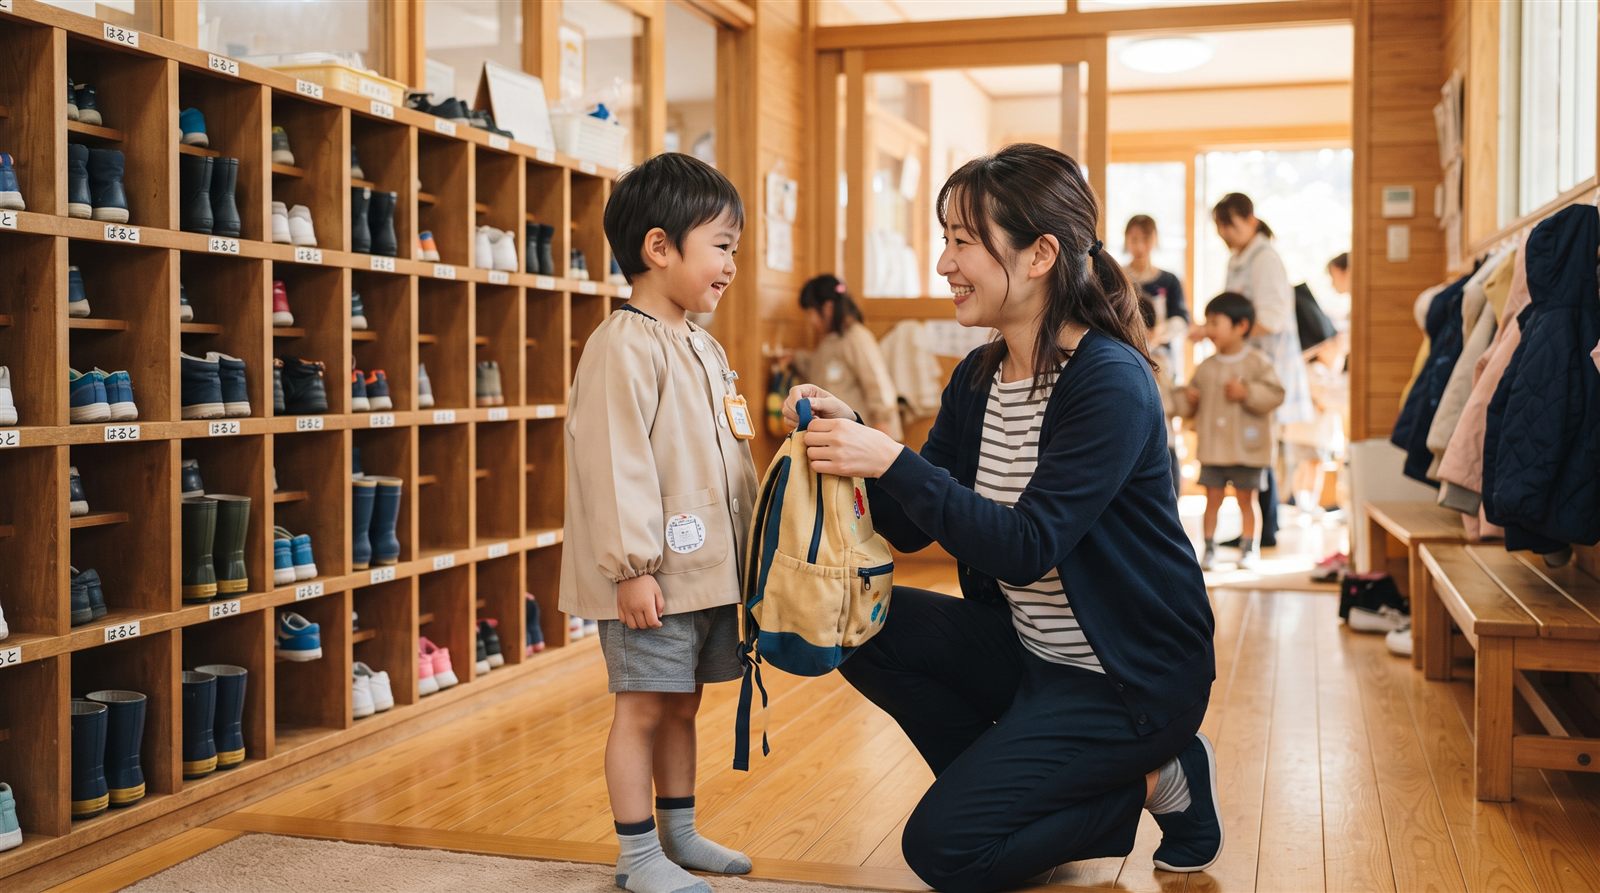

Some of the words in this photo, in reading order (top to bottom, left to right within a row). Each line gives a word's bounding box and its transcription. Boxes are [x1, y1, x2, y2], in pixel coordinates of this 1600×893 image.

[106, 27, 135, 45] はると
[211, 56, 236, 74] はると
[298, 81, 320, 97] はると
[107, 227, 136, 241] はると
[211, 239, 237, 252] はると
[107, 427, 137, 440] はると
[211, 423, 237, 434] はると
[212, 602, 237, 617] はると
[107, 625, 136, 641] はると
